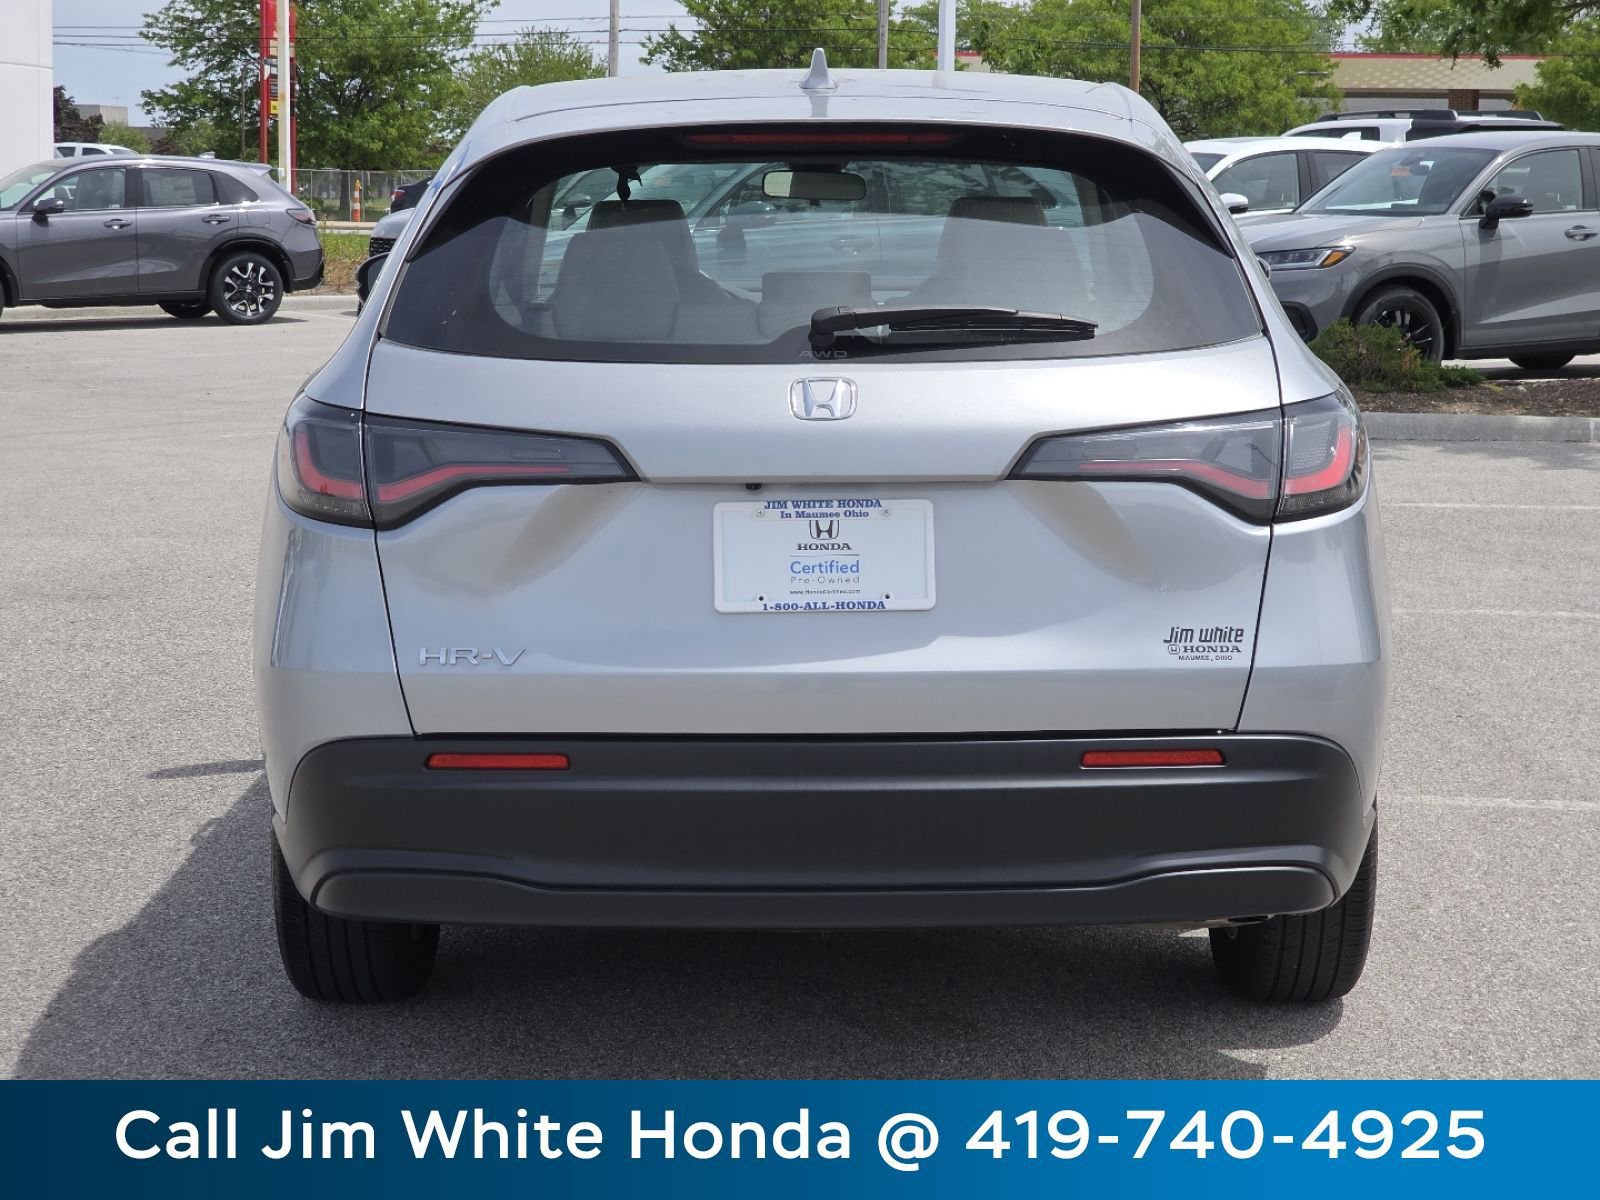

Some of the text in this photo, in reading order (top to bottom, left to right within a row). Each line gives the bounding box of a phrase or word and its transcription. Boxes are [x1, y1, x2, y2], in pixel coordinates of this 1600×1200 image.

[798, 350, 848, 358] AWD
[764, 499, 882, 510] JIM WHITE HONDA
[780, 509, 869, 519] In Maumee Ohio
[797, 543, 852, 551] HONDA
[790, 559, 860, 574] Certified
[790, 576, 860, 584] Pre-Owned
[762, 600, 886, 611] 1-800-ALL-HONDA
[1163, 626, 1194, 643] Jim
[1183, 645, 1242, 653] HONDA
[419, 647, 526, 665] HR-V
